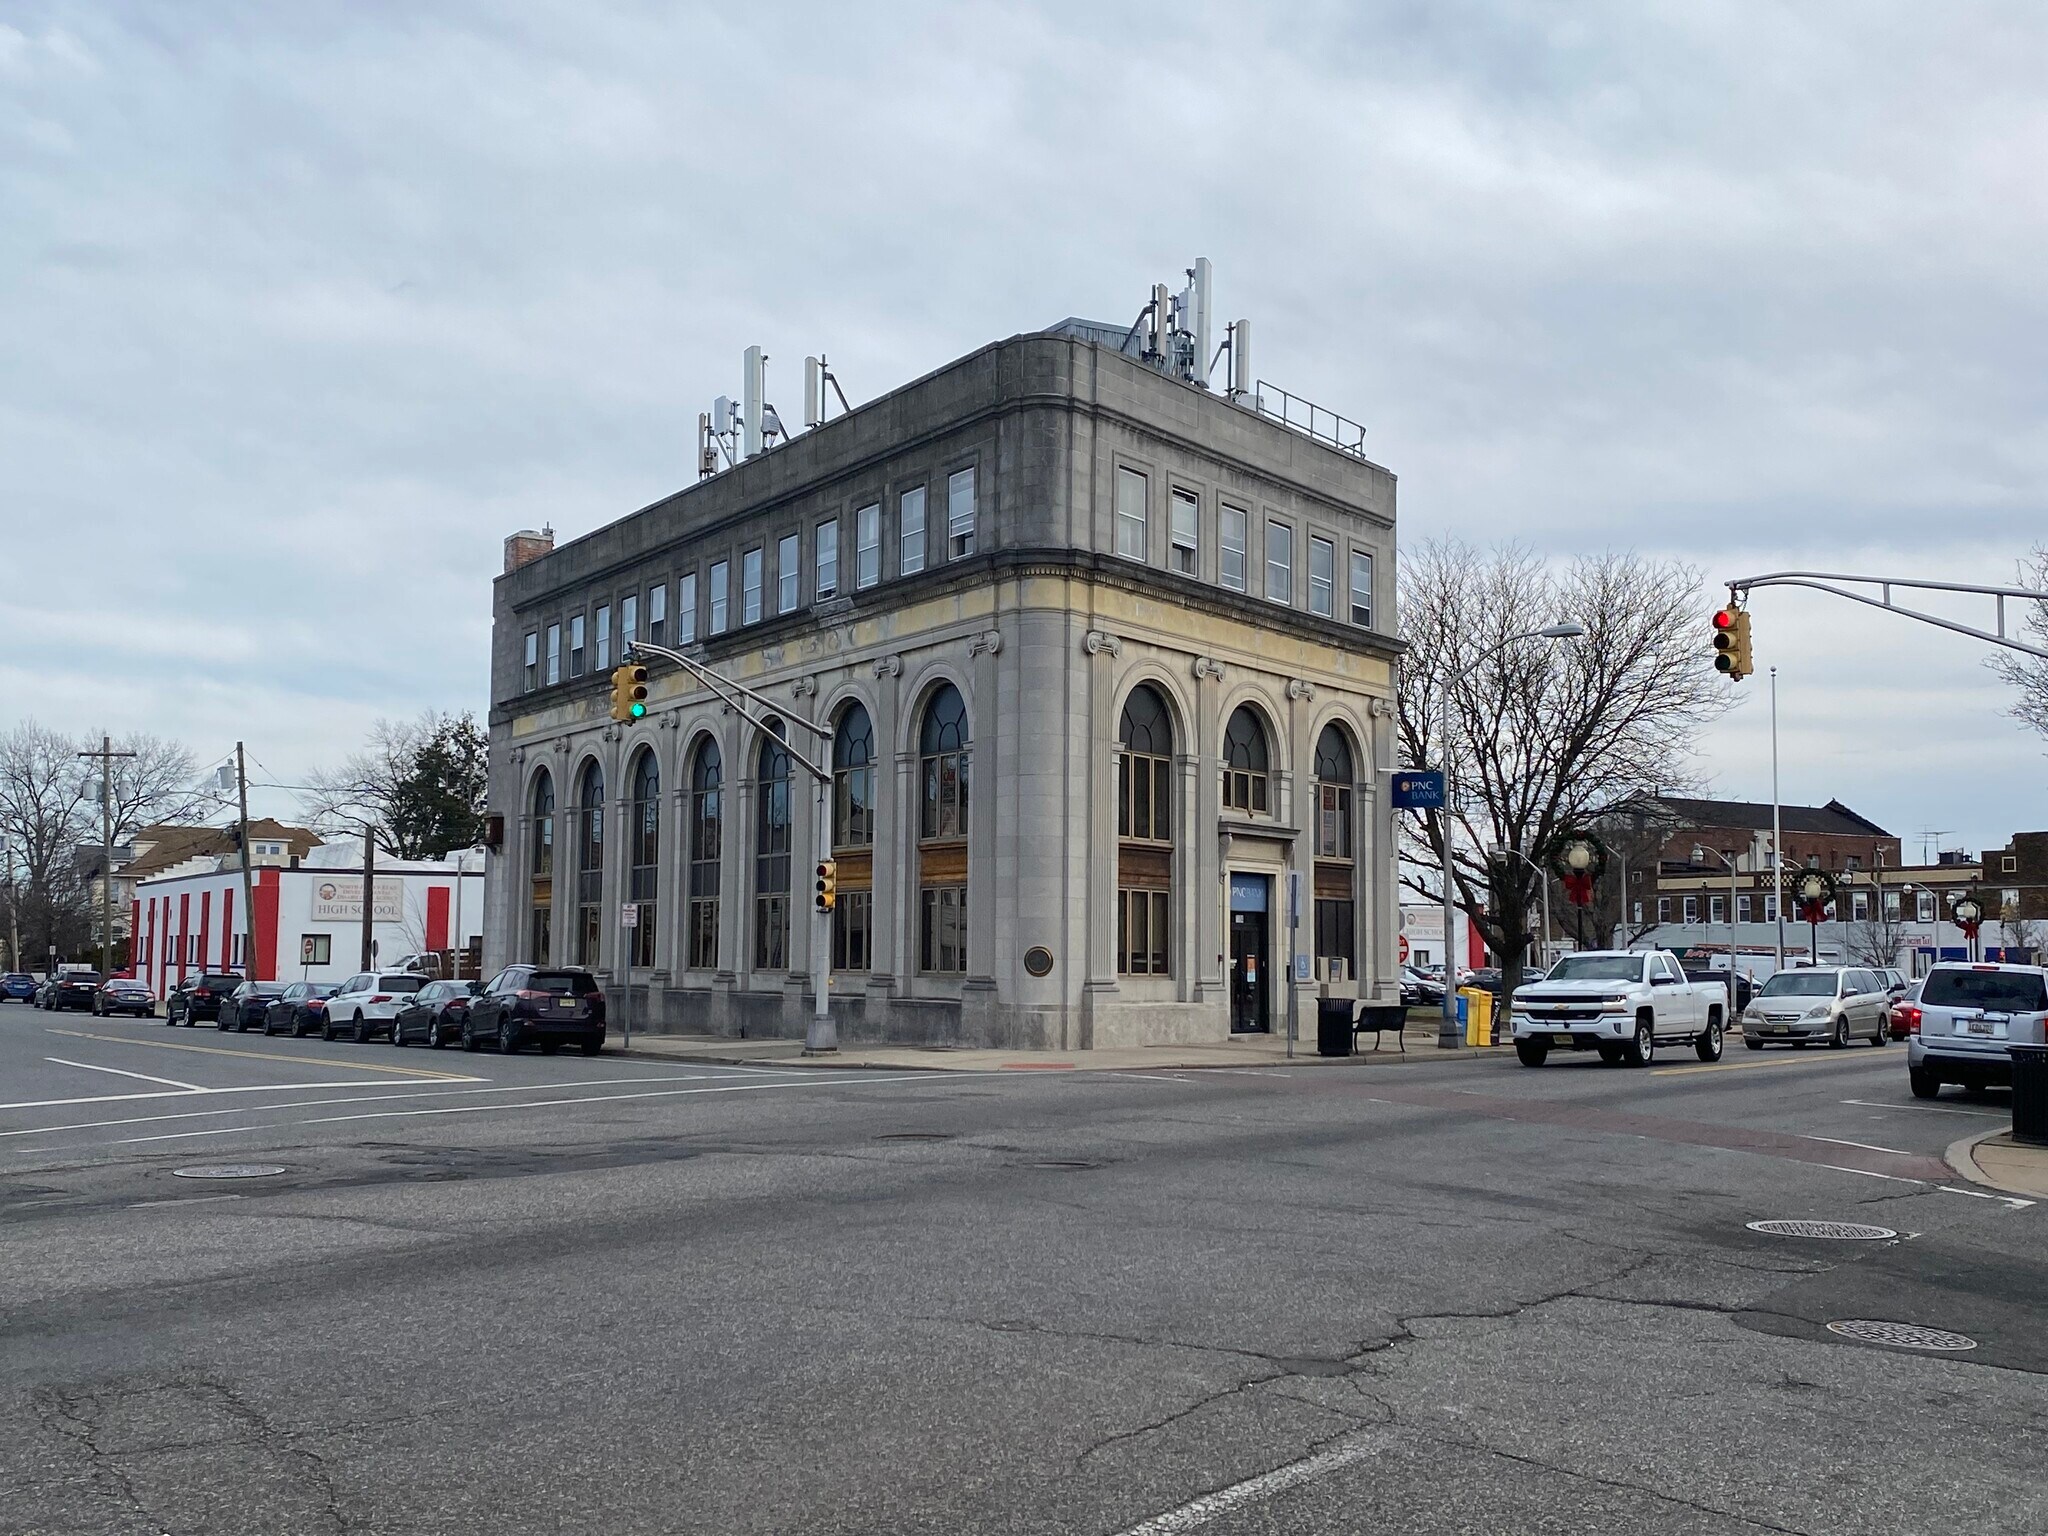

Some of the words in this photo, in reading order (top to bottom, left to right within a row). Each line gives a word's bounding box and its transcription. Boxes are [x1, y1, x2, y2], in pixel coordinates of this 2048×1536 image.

[1411, 781, 1434, 790] PNC
[1411, 791, 1440, 800] BANK
[318, 904, 348, 914] HIGH
[351, 905, 398, 915] SCOOL
